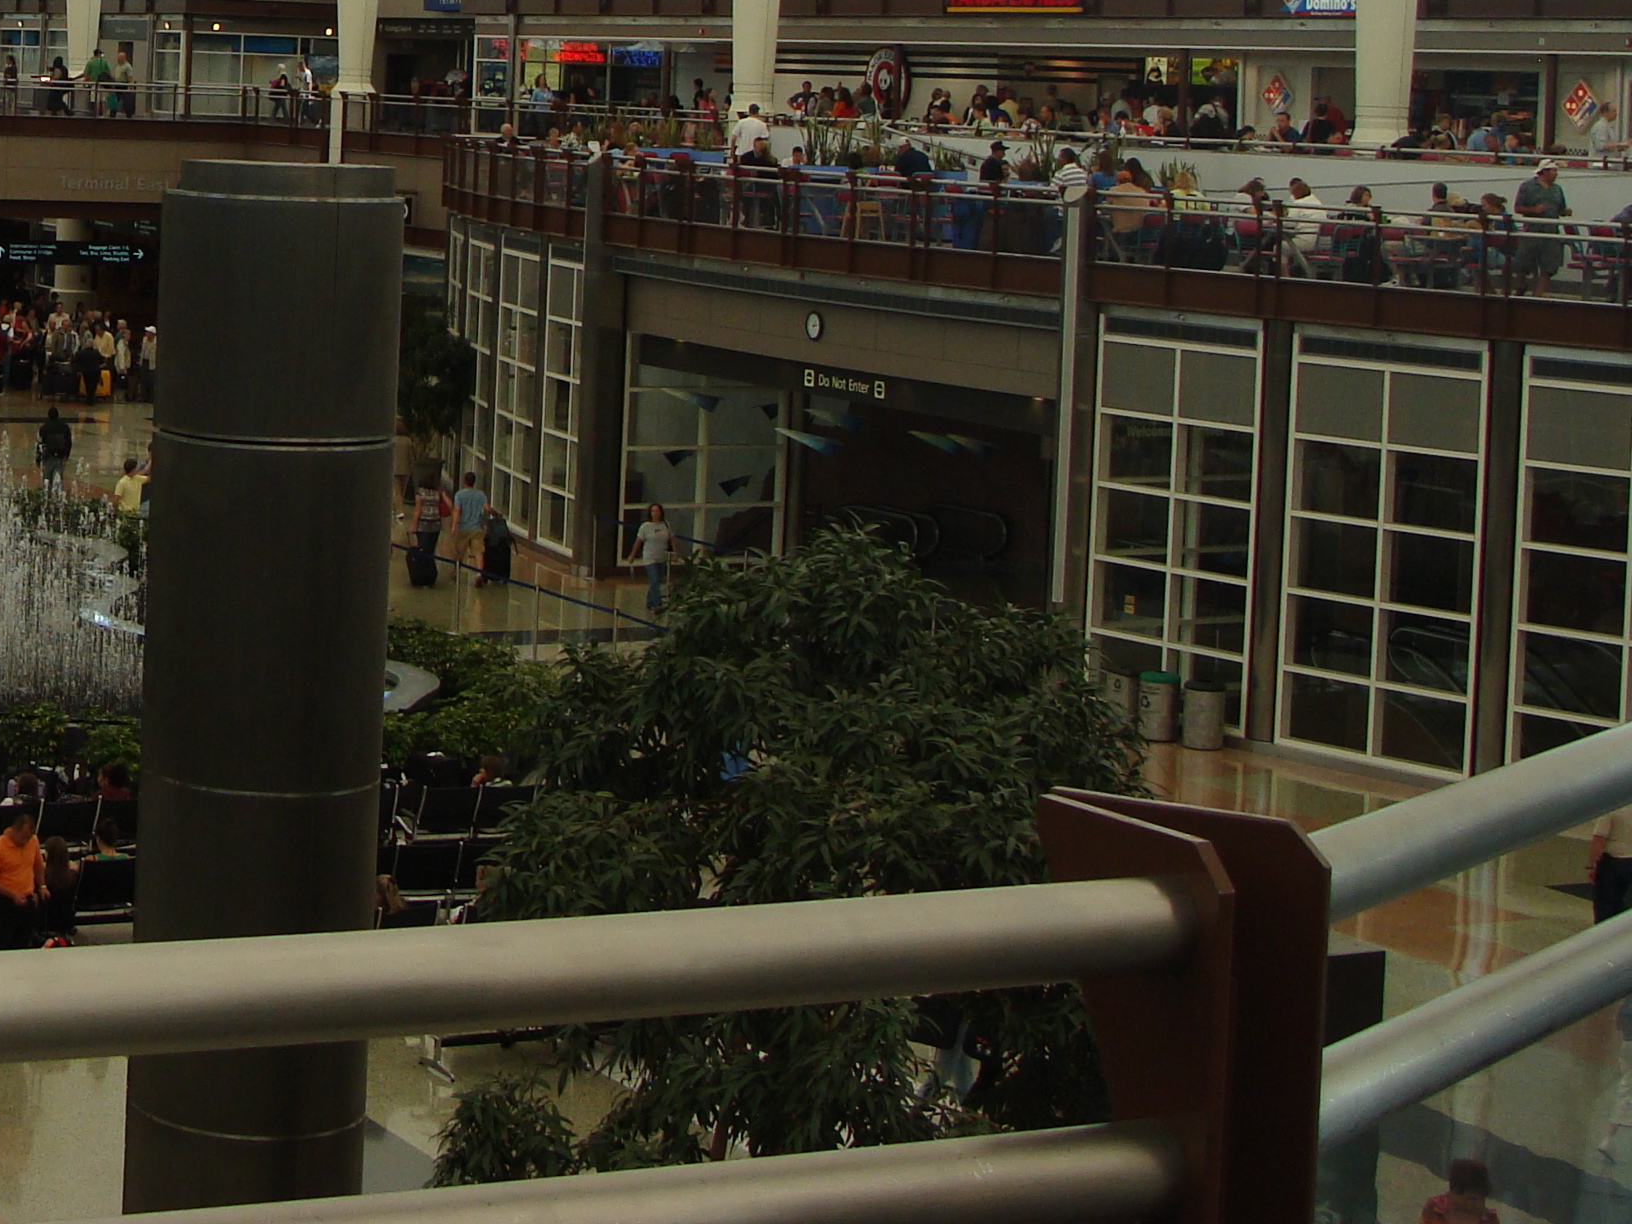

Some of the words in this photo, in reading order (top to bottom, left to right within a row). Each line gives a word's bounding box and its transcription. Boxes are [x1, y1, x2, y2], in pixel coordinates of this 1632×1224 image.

[60, 175, 130, 190] Terminal
[818, 374, 830, 387] Do
[832, 376, 846, 391] Not
[848, 378, 870, 394] Enter
